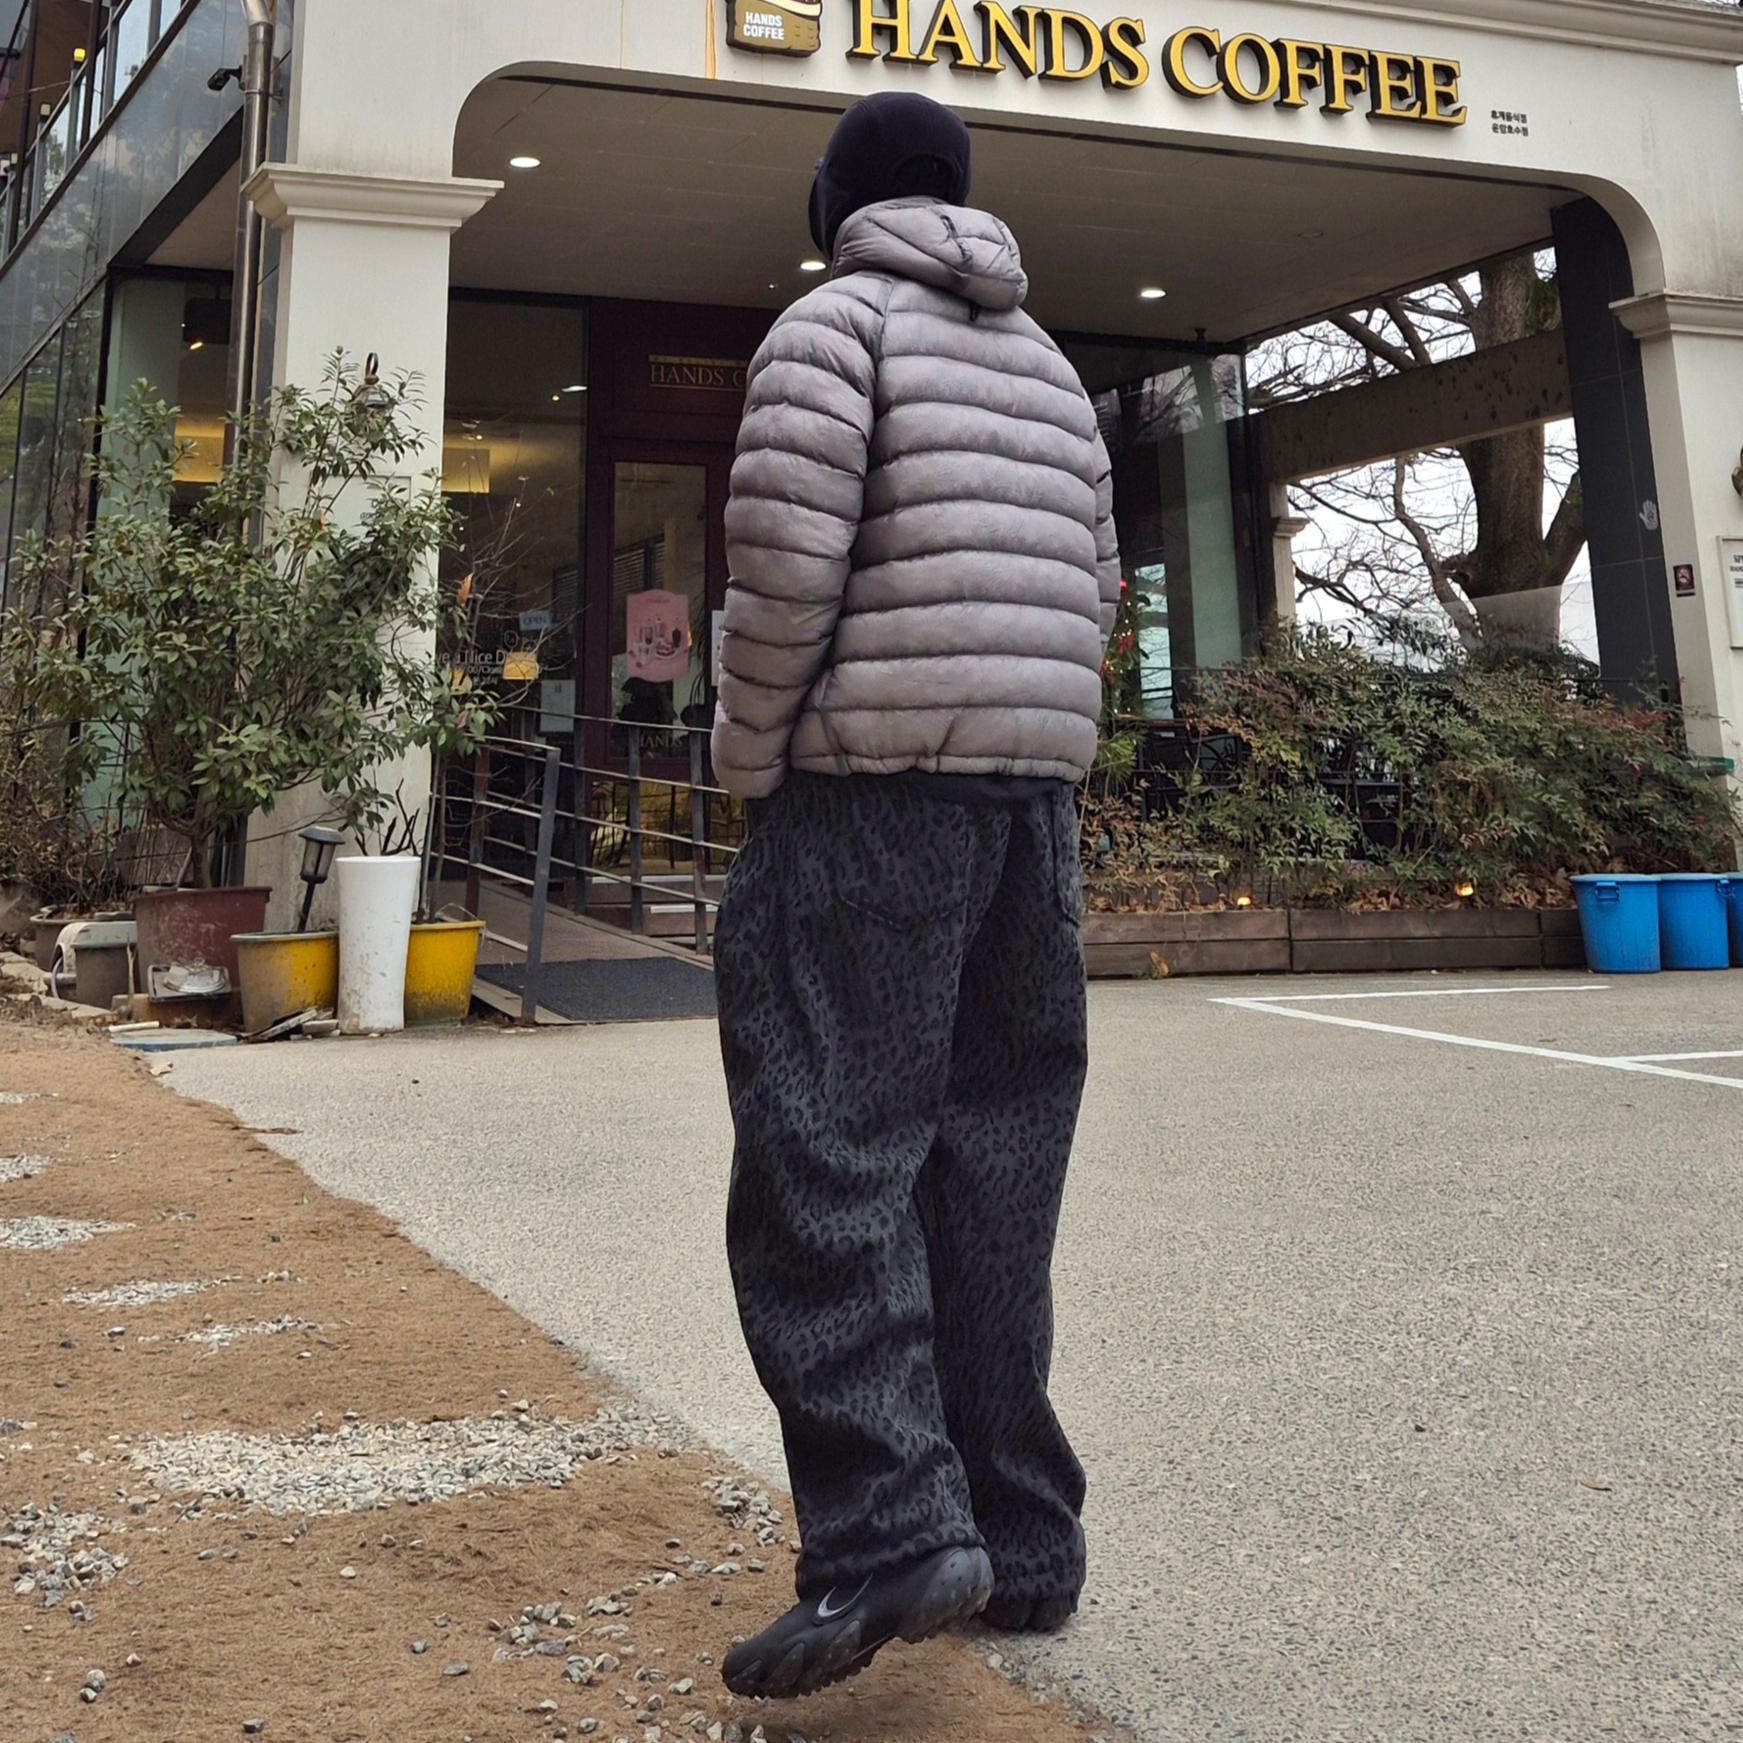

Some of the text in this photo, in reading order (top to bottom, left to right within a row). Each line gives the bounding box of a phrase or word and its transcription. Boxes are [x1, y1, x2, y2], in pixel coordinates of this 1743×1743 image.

[745, 11, 782, 27] HANDS
[743, 24, 785, 41] COFFEE
[845, 0, 1468, 126] HANDS COFFEE
[650, 364, 724, 386] HANDS
